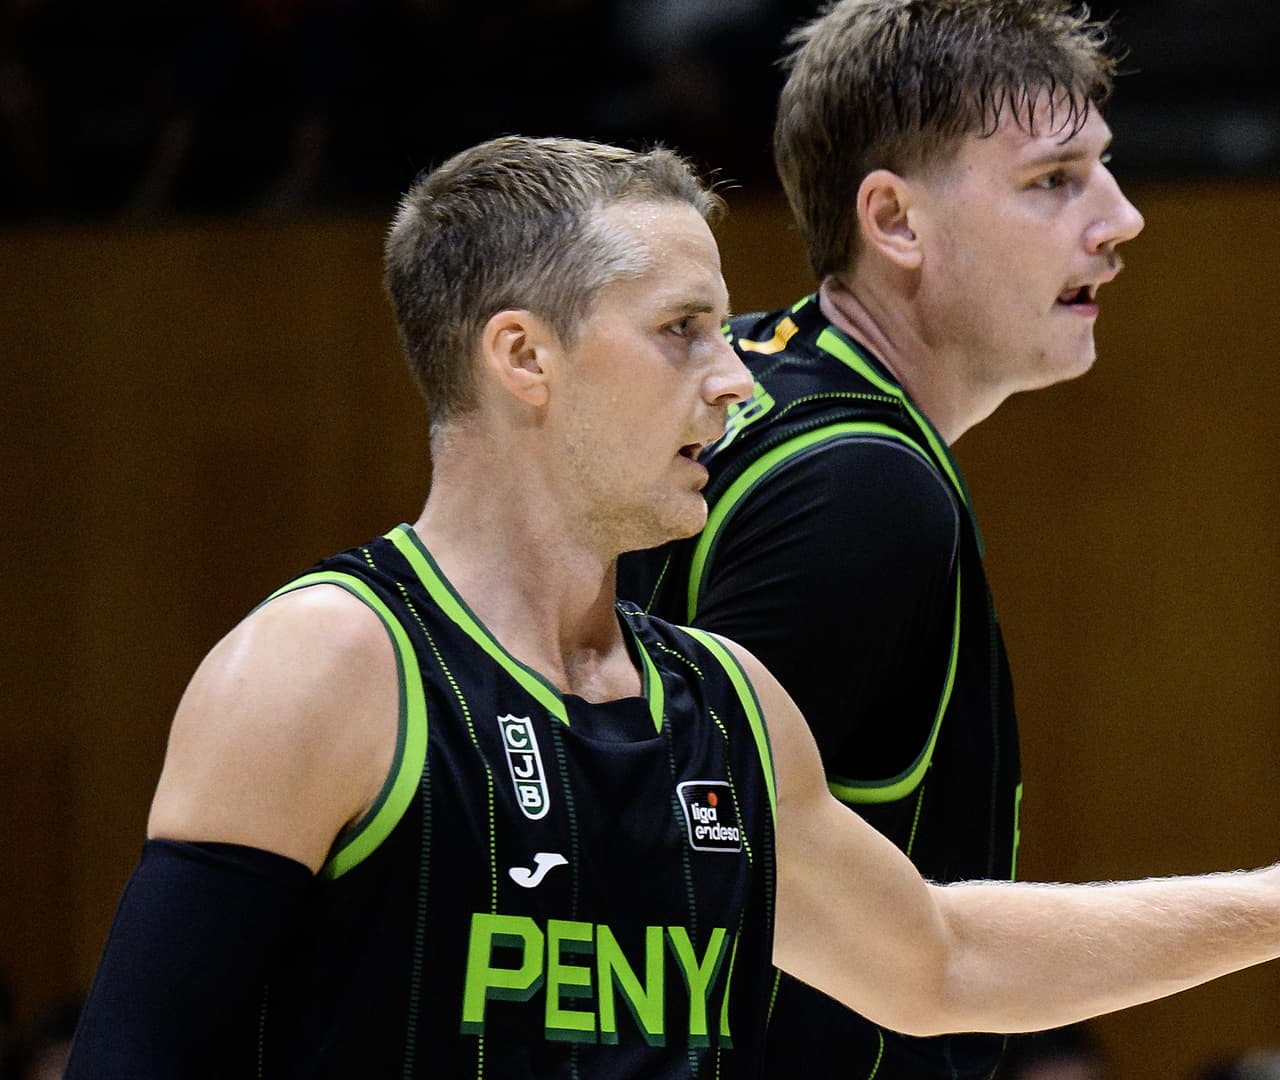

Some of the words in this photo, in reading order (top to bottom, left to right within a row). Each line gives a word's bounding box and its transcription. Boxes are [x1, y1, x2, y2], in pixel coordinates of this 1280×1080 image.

[691, 803, 717, 824] liga
[695, 824, 740, 842] endesa
[460, 912, 738, 1049] PENY
